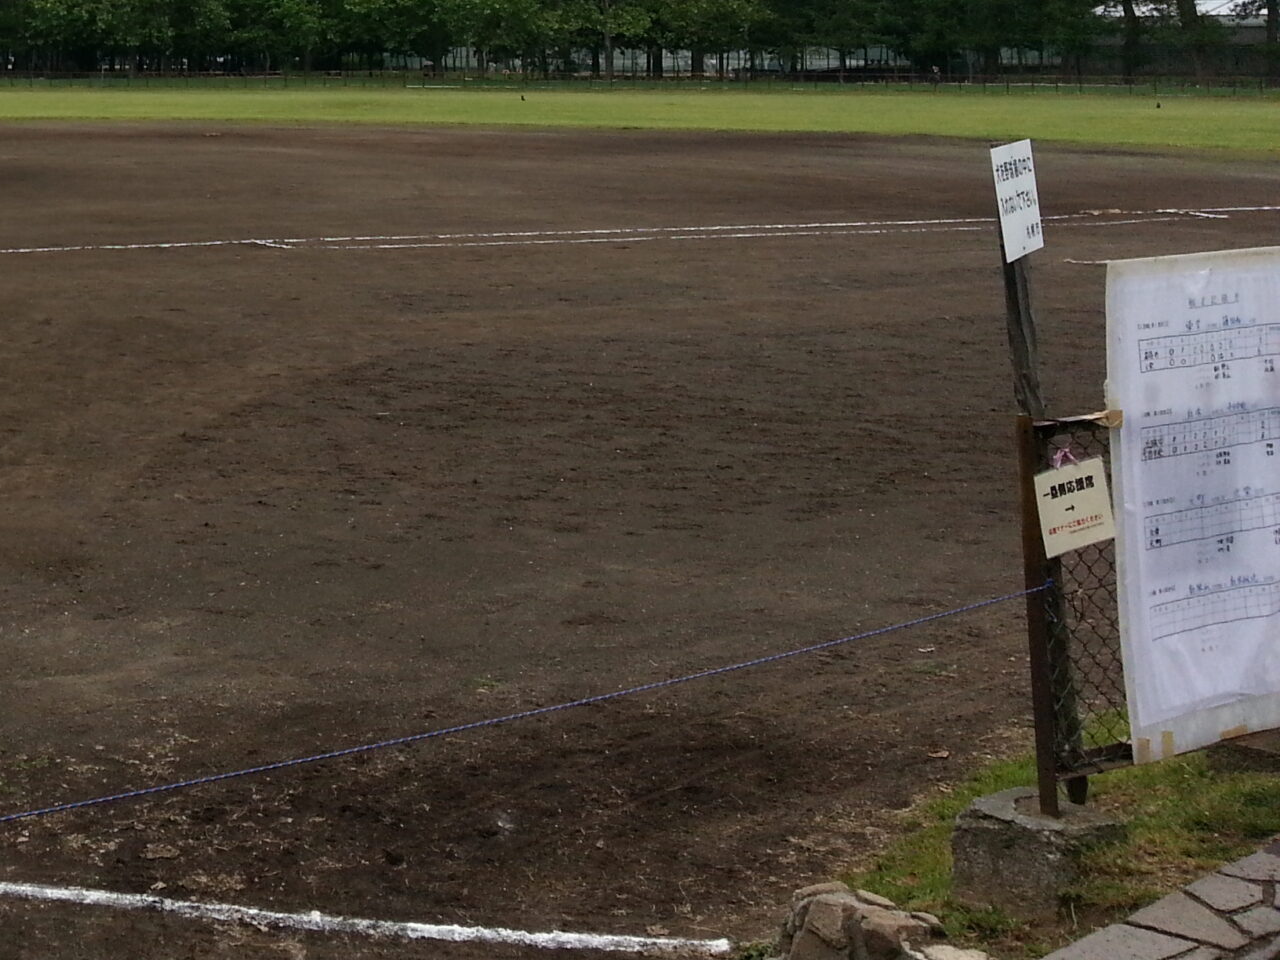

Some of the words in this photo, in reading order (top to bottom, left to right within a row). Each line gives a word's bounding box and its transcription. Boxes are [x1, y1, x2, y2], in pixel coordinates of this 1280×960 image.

[1043, 475, 1094, 499] 一塁側応援席
